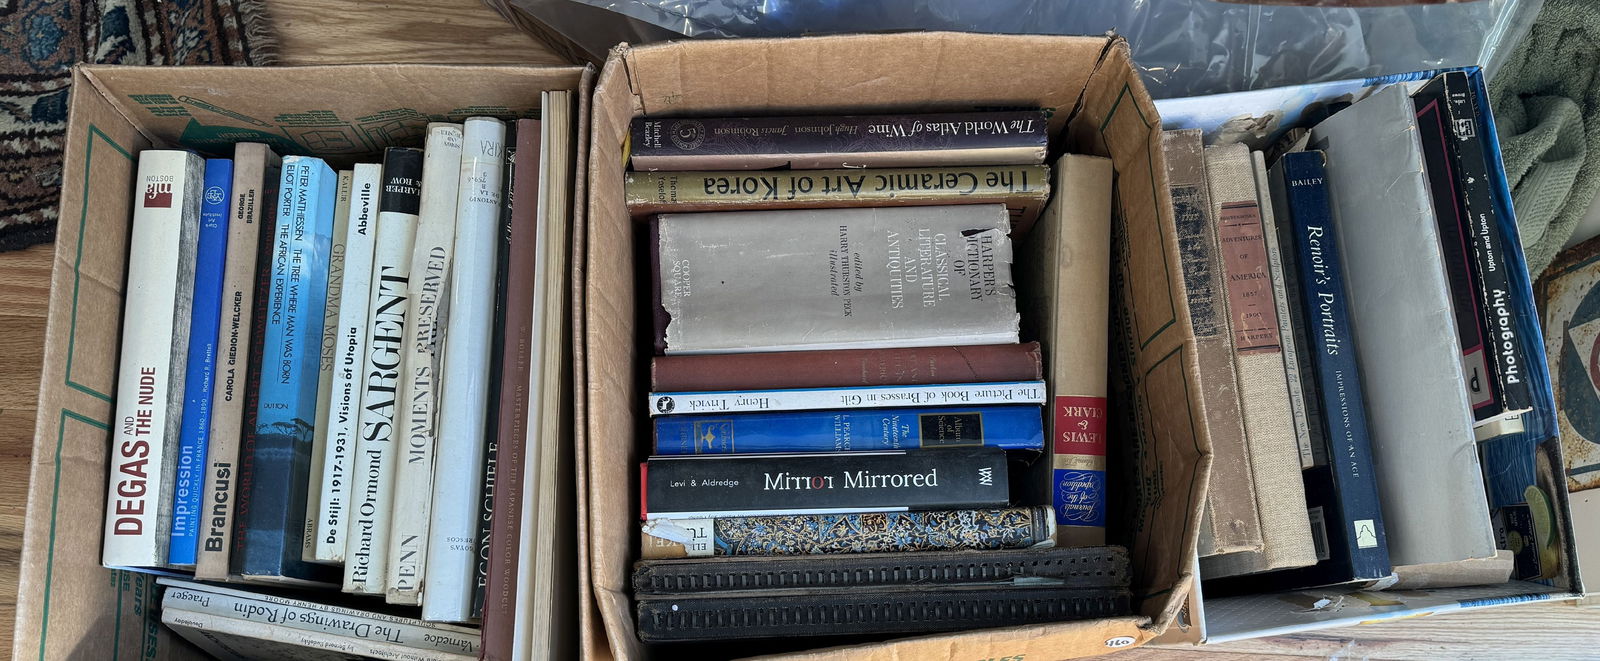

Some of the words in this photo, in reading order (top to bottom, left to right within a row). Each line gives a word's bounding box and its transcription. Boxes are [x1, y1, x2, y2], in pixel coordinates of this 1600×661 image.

[653, 120, 662, 148] Mitchell
[714, 127, 759, 137] Robinson
[794, 124, 833, 136] Johnson
[834, 124, 858, 136] Hugh
[868, 123, 906, 138] Wine
[908, 120, 924, 137] of
[926, 122, 962, 135] Atlas
[965, 120, 1008, 135] World
[1010, 119, 1034, 134] The
[285, 164, 295, 185] ELIOT
[391, 176, 413, 186] ROW
[875, 172, 978, 196] Ceramic
[986, 170, 1034, 194] The
[1292, 178, 1324, 187] BAILEY
[145, 183, 173, 200] mfa
[704, 176, 778, 200] Korea
[787, 176, 814, 200] of
[822, 174, 866, 198] Art
[238, 193, 246, 220] GEORGE
[247, 189, 255, 224] BRAZILLER
[282, 187, 294, 216] PORTER
[358, 182, 372, 236] Abbeville
[294, 190, 308, 241] MATTHIESSEN
[1480, 213, 1490, 235] Upton
[281, 224, 290, 238] THE
[840, 225, 849, 254] HARRY
[1484, 235, 1492, 250] and
[276, 239, 288, 276] AFRICAN
[293, 249, 302, 264] THE
[854, 252, 864, 280] edited
[981, 235, 998, 297] HARPER'S
[1271, 246, 1282, 282] Sculptors
[1307, 225, 1331, 286] Renoir's
[1486, 252, 1496, 272] Upton
[291, 264, 300, 282] TREE
[829, 249, 840, 297] illustrated
[841, 256, 850, 296] THURSTON
[886, 230, 904, 310] ANTIQUITIES
[904, 256, 918, 284] AND
[918, 228, 936, 308] LITERATURE
[934, 233, 950, 301] CLASSICAL
[954, 260, 966, 276] OF
[1230, 272, 1268, 282] AMERICA
[326, 244, 345, 319] GRANDMA
[672, 260, 682, 298] SQUARE
[682, 260, 691, 298] COOPER
[854, 281, 864, 293] by
[272, 279, 284, 325] EXPERIENCE
[288, 284, 299, 314] WHERE
[416, 246, 446, 354] PRESERVED
[1277, 283, 1285, 301] and
[286, 315, 296, 334] MAN
[1280, 301, 1290, 333] Painters
[1318, 292, 1342, 356] Portraits
[284, 336, 294, 358] WAS
[348, 327, 359, 362] Utopia
[1492, 288, 1520, 384] Photography
[320, 326, 337, 372] MOSES
[362, 266, 410, 442] SARGENT
[1285, 336, 1297, 370] European
[281, 360, 292, 384] BORN
[346, 368, 352, 381] of
[1289, 372, 1298, 383] 22
[138, 367, 156, 407] NUDE
[225, 368, 235, 402] CAROLA
[941, 390, 970, 402] Book
[974, 389, 1013, 400] Picture
[1017, 388, 1040, 400] The
[338, 390, 352, 424] Visions
[689, 398, 730, 411] Trivick
[734, 397, 770, 410] Henry
[841, 394, 862, 406] Gilt
[866, 393, 877, 404] in
[880, 392, 920, 404] Brasses
[924, 392, 936, 403] of
[1336, 370, 1350, 429] IMPRESSIONS
[408, 366, 432, 466] MOMENTS
[1062, 406, 1104, 417] CLARK
[124, 416, 134, 436] AND
[135, 410, 152, 436] THE
[881, 417, 890, 447] Century
[901, 424, 910, 438] The
[946, 424, 954, 434] of
[954, 416, 964, 442] Album
[1078, 420, 1090, 430] &
[1299, 424, 1307, 440] New
[1062, 432, 1103, 443] LEWIS
[1345, 430, 1354, 442] OF
[332, 426, 348, 492] 1917-1931,
[1303, 444, 1311, 458] The
[1348, 444, 1356, 459] AN
[196, 464, 201, 474] IN
[670, 480, 686, 488] Levi
[690, 479, 697, 487] &
[701, 478, 740, 488] Aldredge
[843, 468, 939, 490] Mirrored
[1351, 461, 1360, 478] AGE
[114, 441, 150, 536] DEGAS
[171, 446, 193, 537] Impression
[192, 474, 200, 503] QUICKLY
[360, 450, 382, 518] Ormond
[204, 462, 231, 552] Brancusi
[328, 496, 340, 526] Stijl:
[188, 504, 198, 537] PAINTING
[304, 518, 314, 548] ABRAMS
[326, 530, 336, 544] De
[352, 519, 374, 584] Richard
[398, 535, 418, 592] PENN
[171, 590, 210, 608] Praeger
[264, 596, 291, 606] MOORE
[292, 600, 319, 610] HENRY
[233, 602, 280, 623] Rodin
[282, 608, 298, 622] of
[300, 612, 372, 638] Drawings
[376, 626, 404, 644] The
[325, 641, 346, 650] Bernard
[369, 649, 399, 658] Architects
[424, 633, 474, 653] Varnedoe
